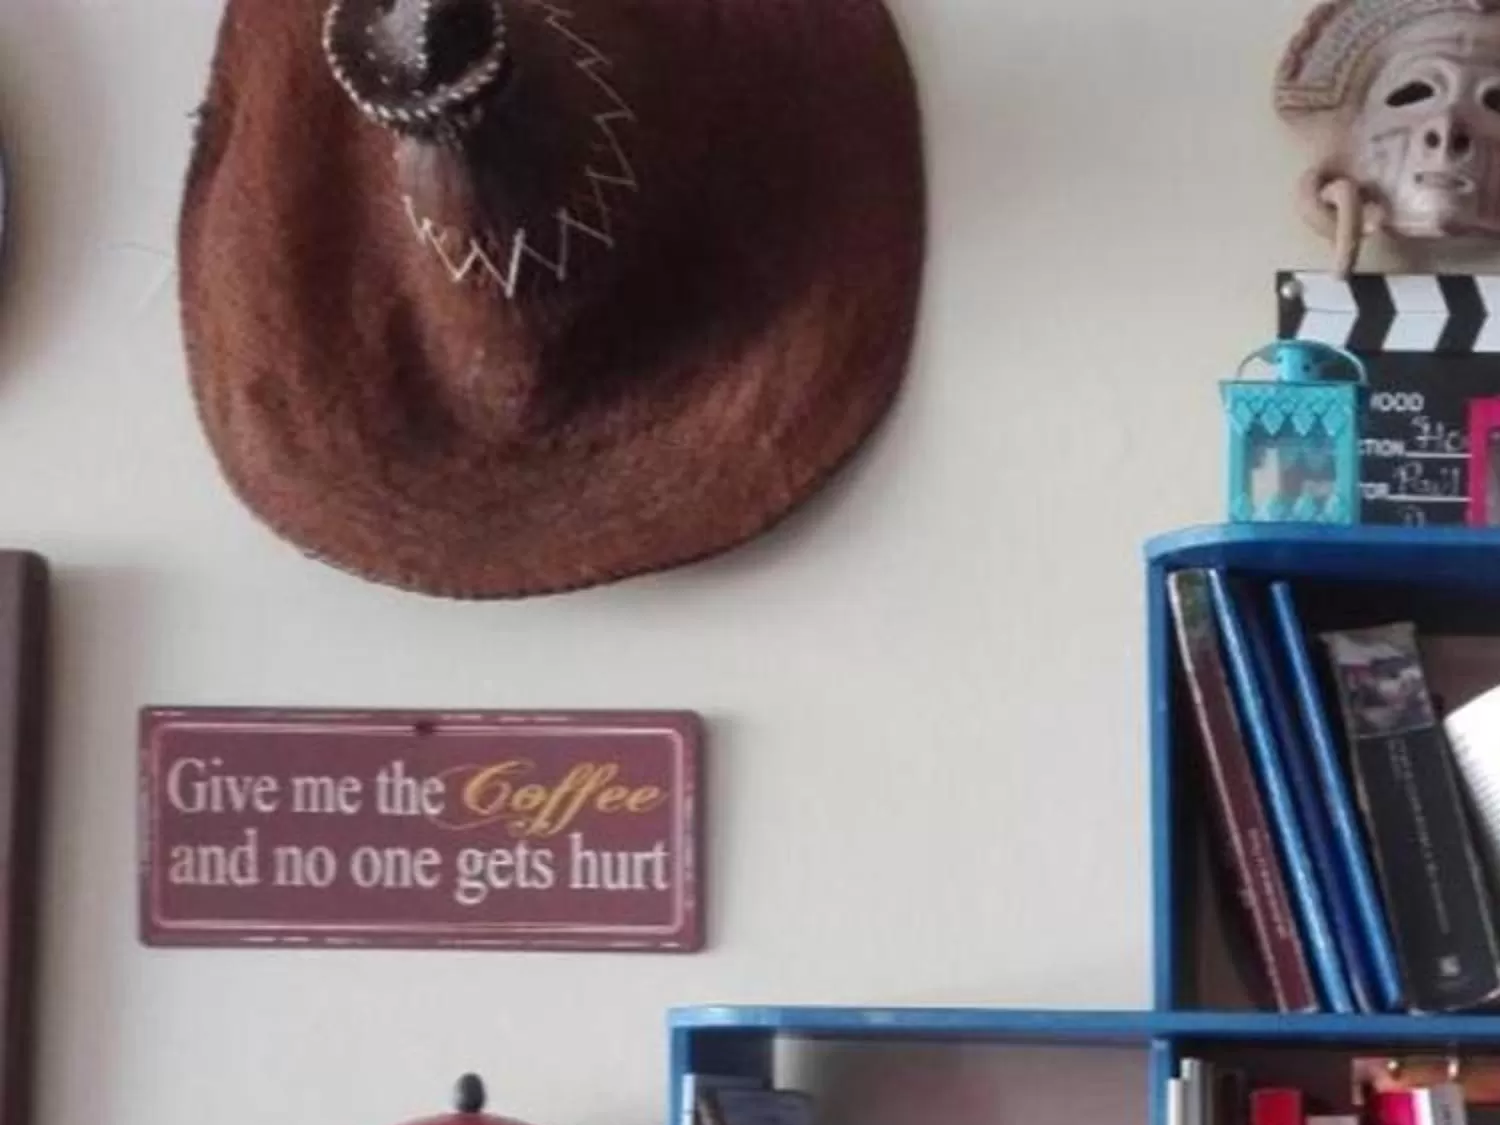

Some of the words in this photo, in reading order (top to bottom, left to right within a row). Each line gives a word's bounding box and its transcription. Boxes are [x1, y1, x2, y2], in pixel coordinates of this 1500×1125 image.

[167, 758, 279, 813] Give
[293, 776, 362, 812] me
[377, 762, 446, 815] the
[436, 760, 666, 836] Coffee
[168, 829, 261, 886] and
[273, 846, 337, 887] no
[351, 846, 441, 889] one
[455, 843, 554, 904] gets
[569, 832, 670, 891] hurt
